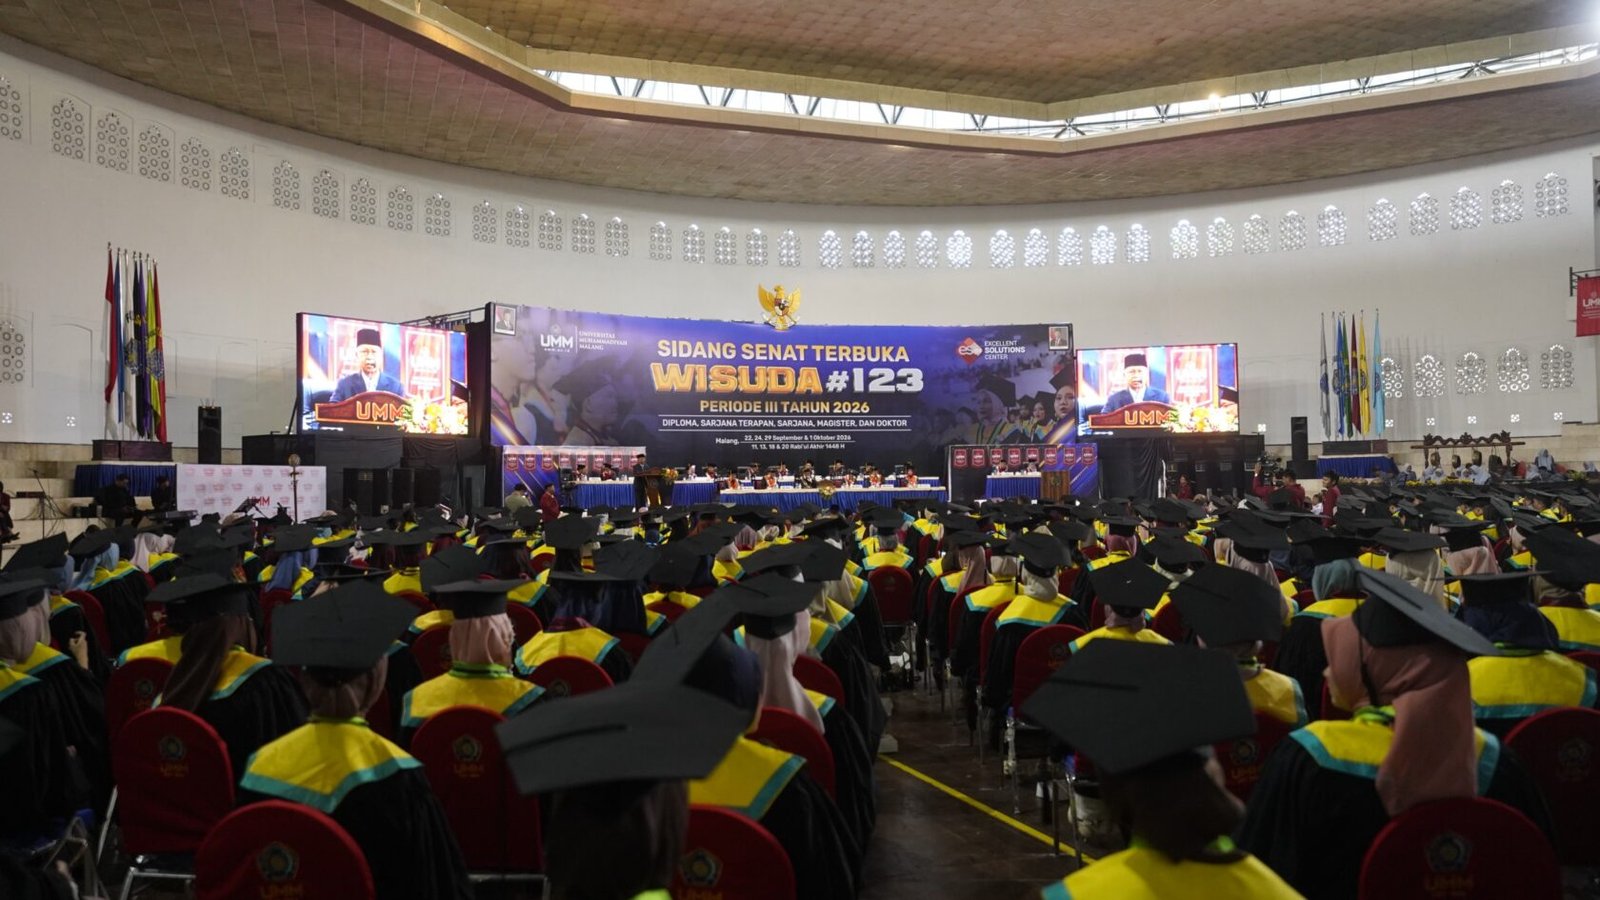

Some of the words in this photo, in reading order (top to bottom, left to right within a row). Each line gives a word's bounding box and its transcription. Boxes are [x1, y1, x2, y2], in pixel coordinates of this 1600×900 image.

[540, 334, 573, 348] UMM
[657, 339, 737, 359] SIDANG
[741, 343, 808, 361] SENAT
[811, 345, 910, 362] TERBUKA
[984, 346, 1026, 354] SOLUTIONS
[650, 362, 823, 394] WISUDA
[826, 367, 924, 393] #123
[356, 400, 405, 421] UMM
[700, 400, 762, 413] PERIODE
[765, 401, 778, 413] III
[781, 401, 830, 413] TAHUN
[833, 401, 870, 414] 2026
[662, 419, 699, 428] DIPLOMA,
[700, 419, 737, 427] SARJANA
[738, 419, 776, 428] TERAPAN,
[777, 419, 815, 428] SARJANA,
[817, 419, 858, 428] MAGISTER,
[859, 419, 875, 427] DAN
[876, 419, 907, 427] DOKTOR
[1124, 410, 1170, 425] UMM
[715, 437, 740, 445] Malang,
[772, 434, 803, 442] September
